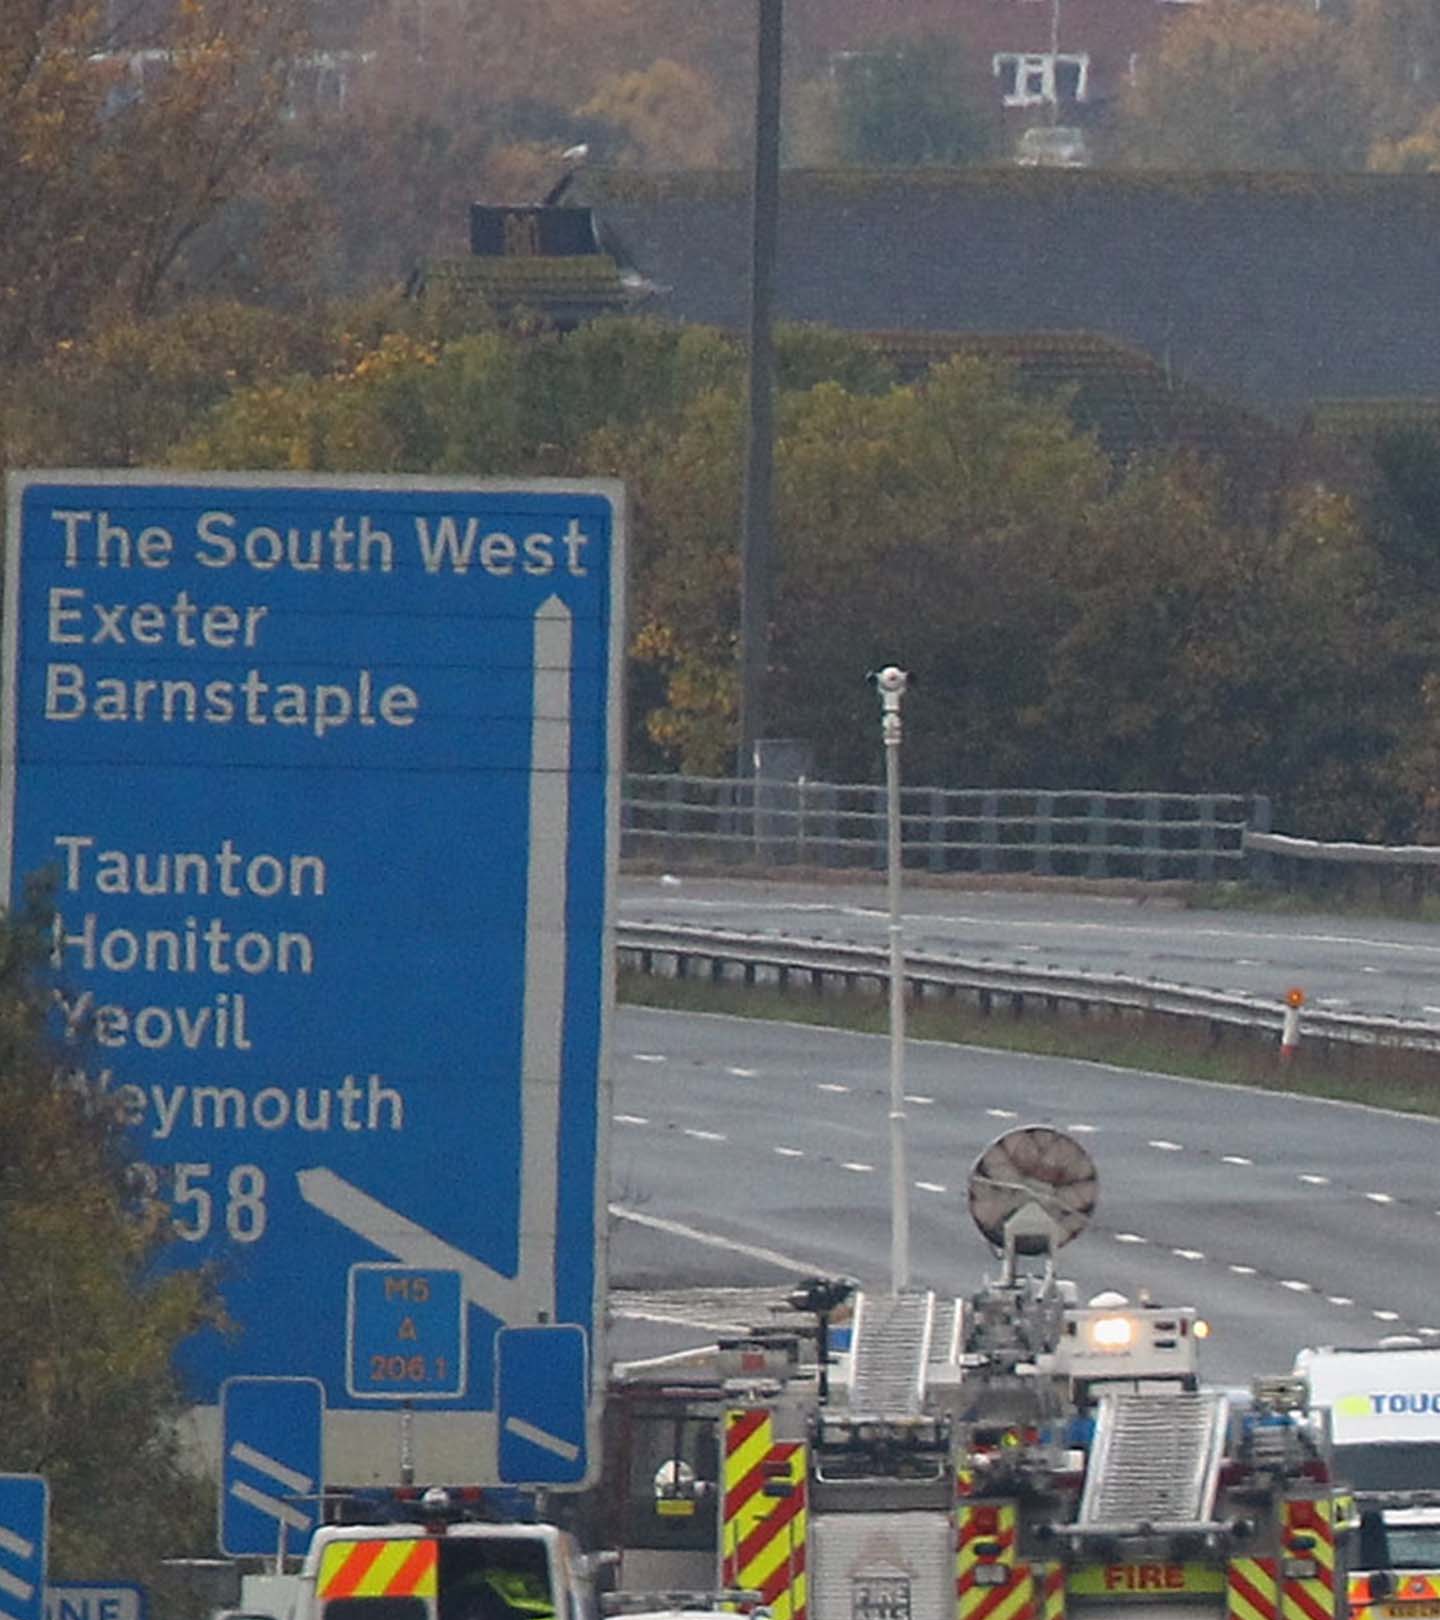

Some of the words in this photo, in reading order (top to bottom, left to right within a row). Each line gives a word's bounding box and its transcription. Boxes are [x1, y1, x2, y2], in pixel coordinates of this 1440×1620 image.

[52, 511, 173, 568] The
[196, 511, 392, 572] South
[416, 517, 588, 576] West
[48, 587, 268, 648] Exeter
[45, 663, 419, 738] Barnstaple
[55, 836, 326, 897] Taunton
[50, 912, 314, 974] Honiton
[384, 1276, 430, 1302] M5
[397, 1316, 417, 1341] A
[370, 1354, 447, 1382] 206.1
[1105, 1562, 1185, 1590] FIRE
